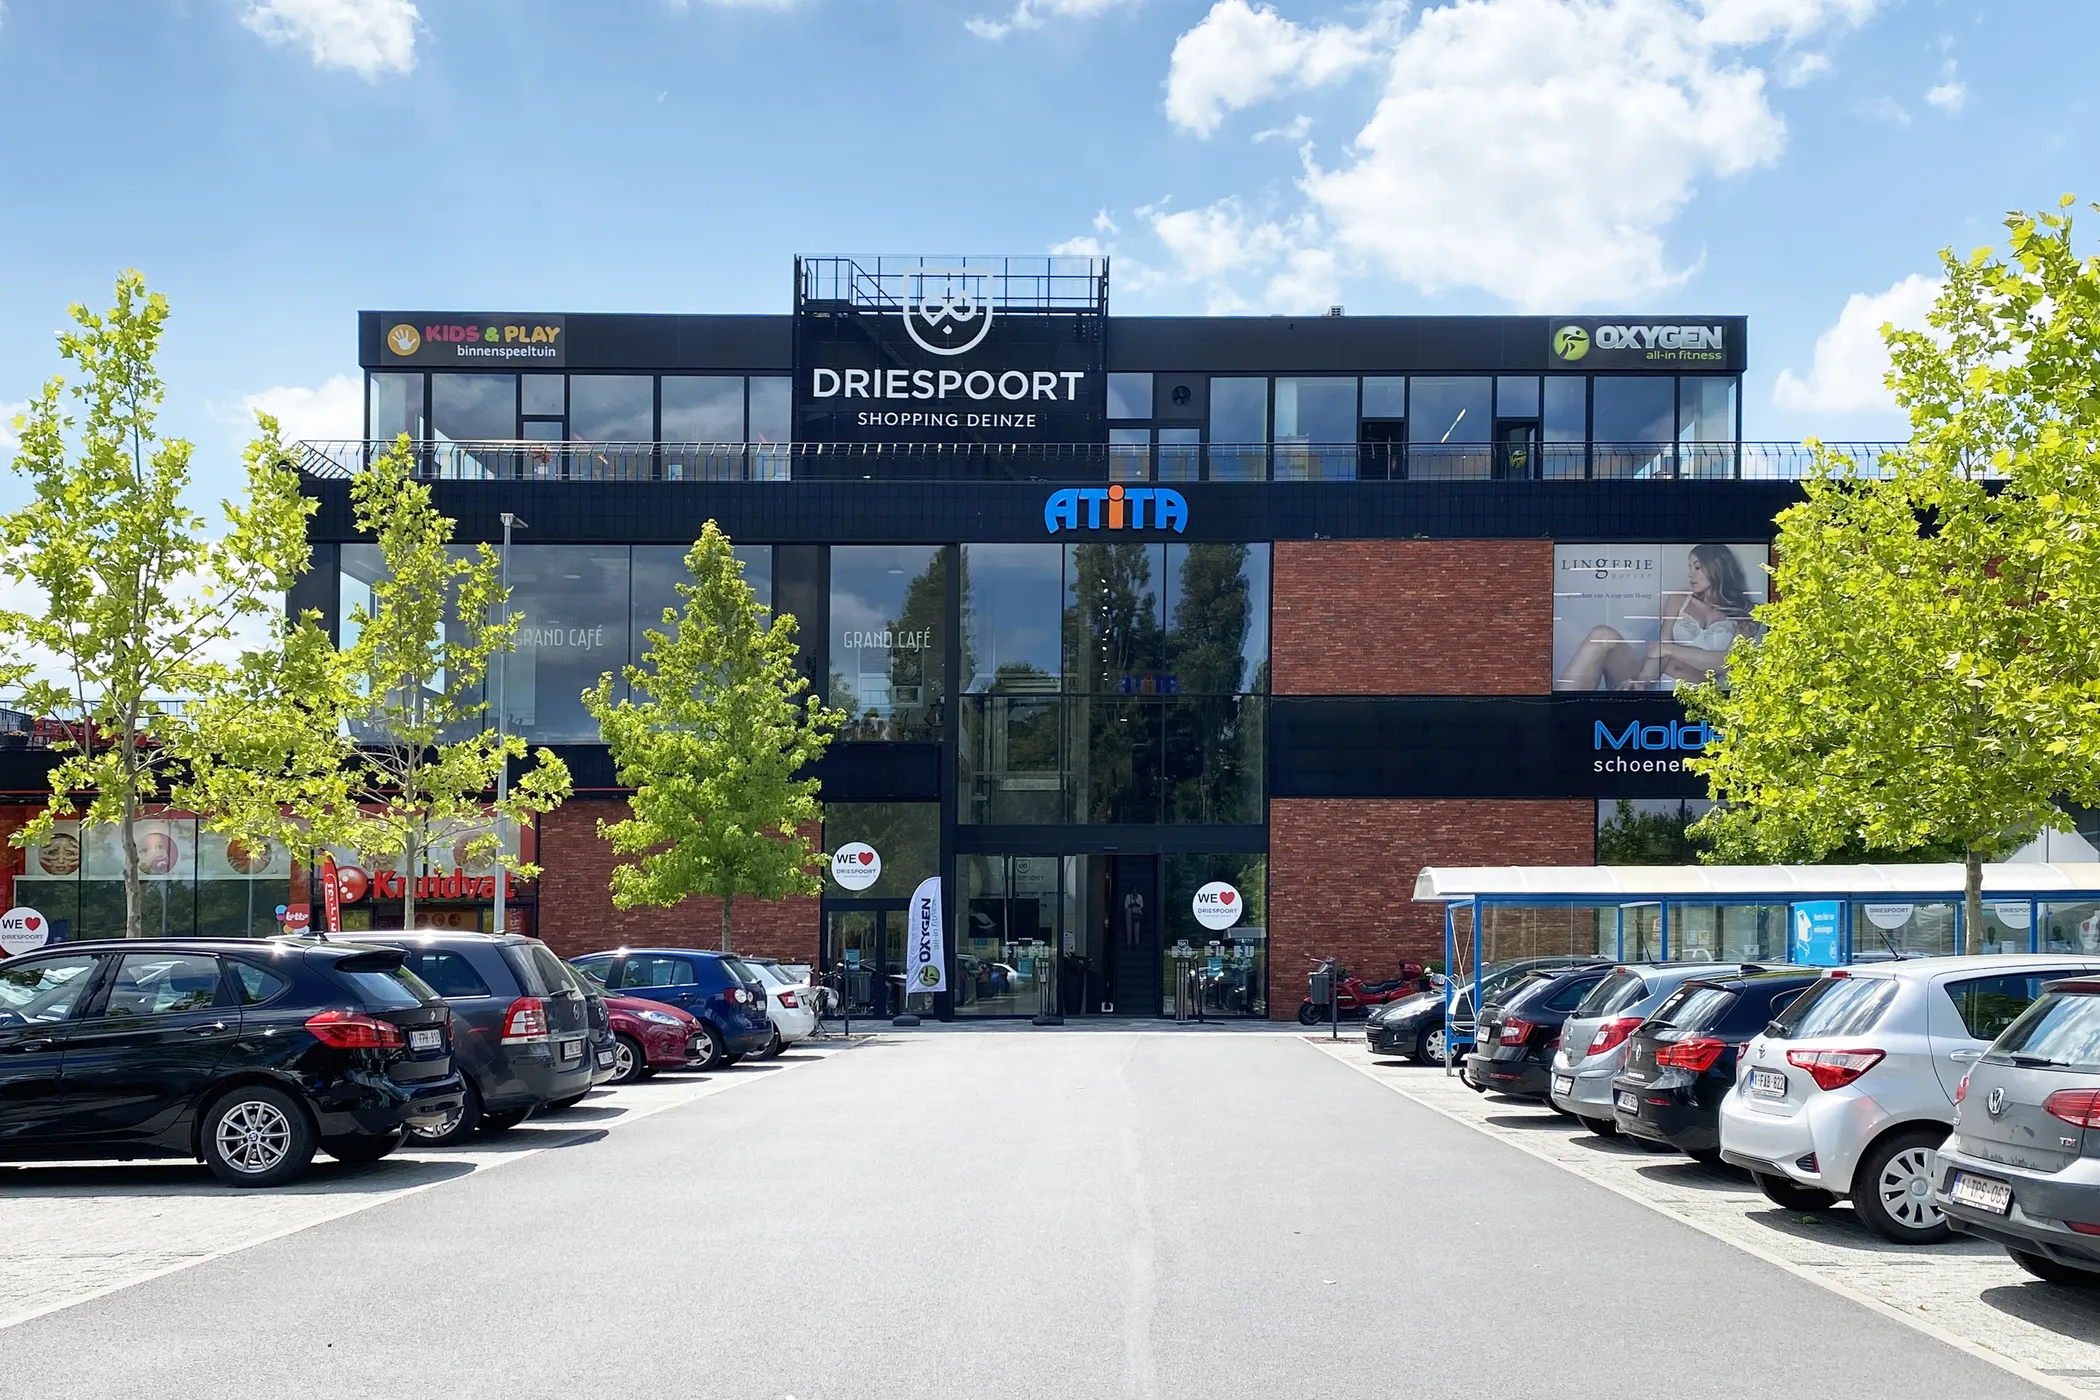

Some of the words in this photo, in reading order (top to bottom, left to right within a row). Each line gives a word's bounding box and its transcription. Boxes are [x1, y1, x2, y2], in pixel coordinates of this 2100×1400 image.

[425, 324, 480, 343] KIDS
[484, 326, 500, 343] &
[504, 324, 561, 344] PLAY
[1595, 325, 1723, 350] OXYGEN
[457, 344, 557, 360] binnenspeeltuin
[1646, 350, 1676, 361] all-in
[1679, 350, 1722, 361] fitness
[812, 367, 1085, 401] DRIESPOORT
[857, 411, 959, 427] SHOPPING
[967, 413, 1037, 428] DEINZE
[513, 628, 564, 647] GRAND
[569, 623, 604, 651] CAFÉ
[843, 630, 893, 649] GRAND
[898, 626, 932, 653] CAFÉ
[836, 853, 857, 864] WE
[1197, 893, 1218, 904] WE
[2, 919, 23, 929] WE
[918, 897, 932, 963] OXYGEN
